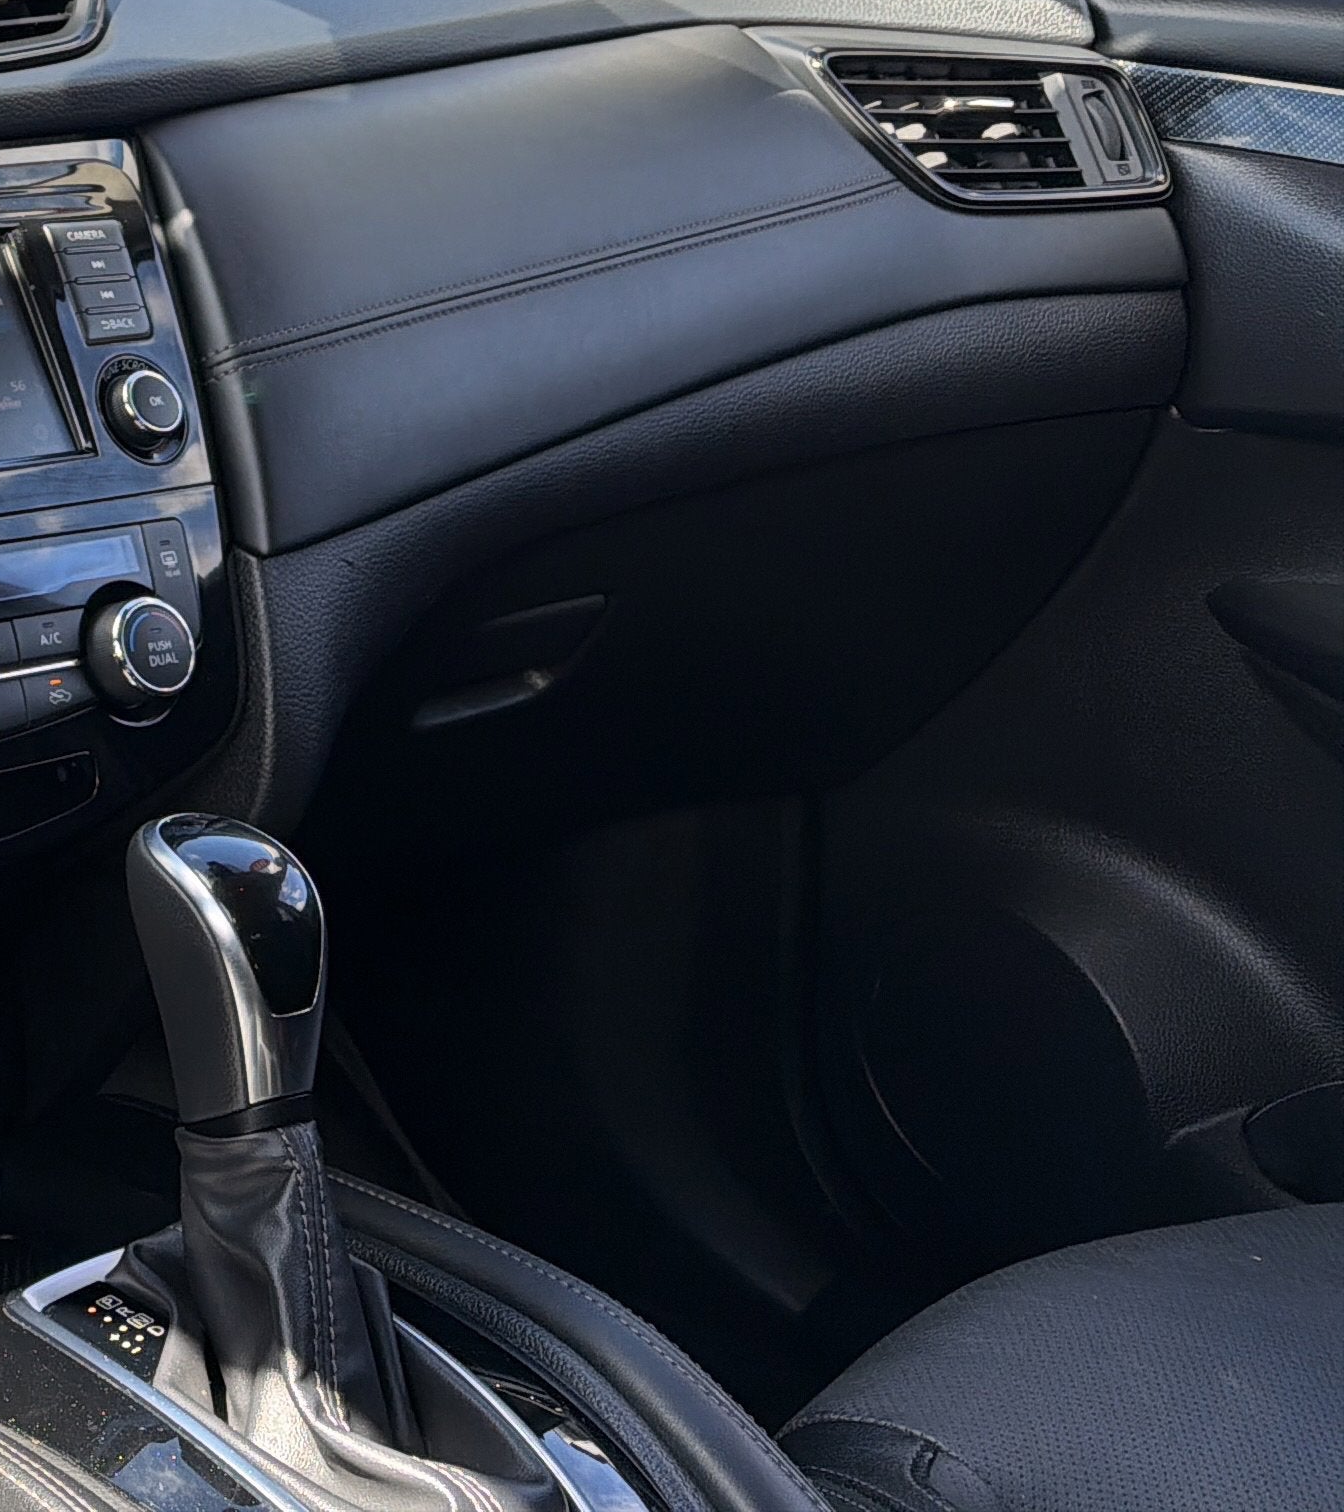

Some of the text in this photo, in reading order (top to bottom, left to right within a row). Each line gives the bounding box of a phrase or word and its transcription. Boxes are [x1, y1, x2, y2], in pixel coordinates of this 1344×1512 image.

[111, 318, 135, 329] BACK
[9, 380, 26, 392] 56
[149, 396, 163, 408] OK
[40, 631, 62, 646] A/C
[148, 640, 173, 653] PUSH
[148, 653, 180, 668] DUAL
[115, 1306, 136, 1318] R
